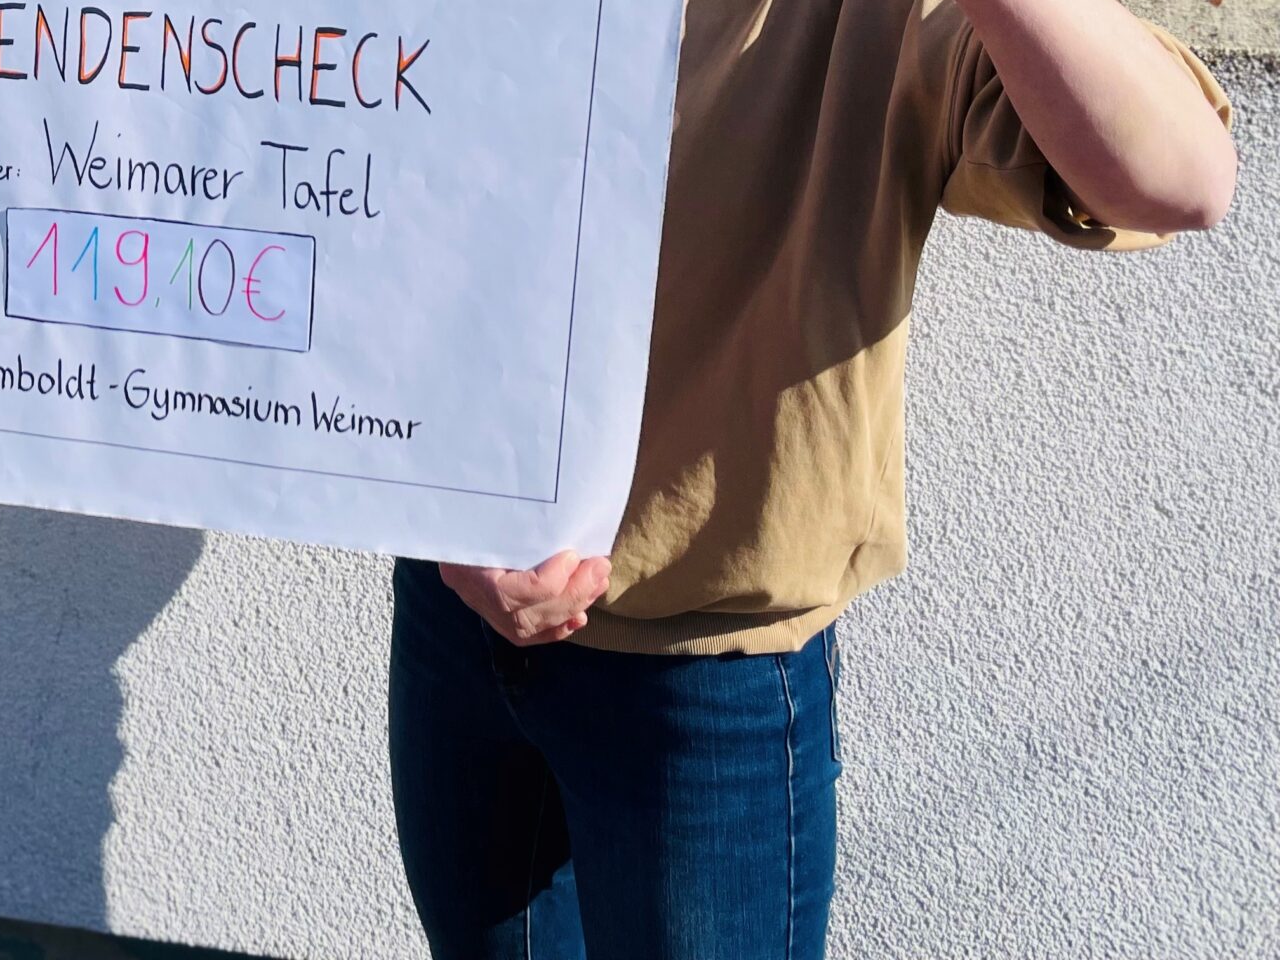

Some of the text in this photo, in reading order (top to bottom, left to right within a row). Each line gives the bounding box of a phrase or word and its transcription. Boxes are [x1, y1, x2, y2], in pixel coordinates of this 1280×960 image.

[43, 117, 244, 202] Weimarer
[260, 140, 381, 220] Tafel
[309, 390, 424, 442] Weimar
